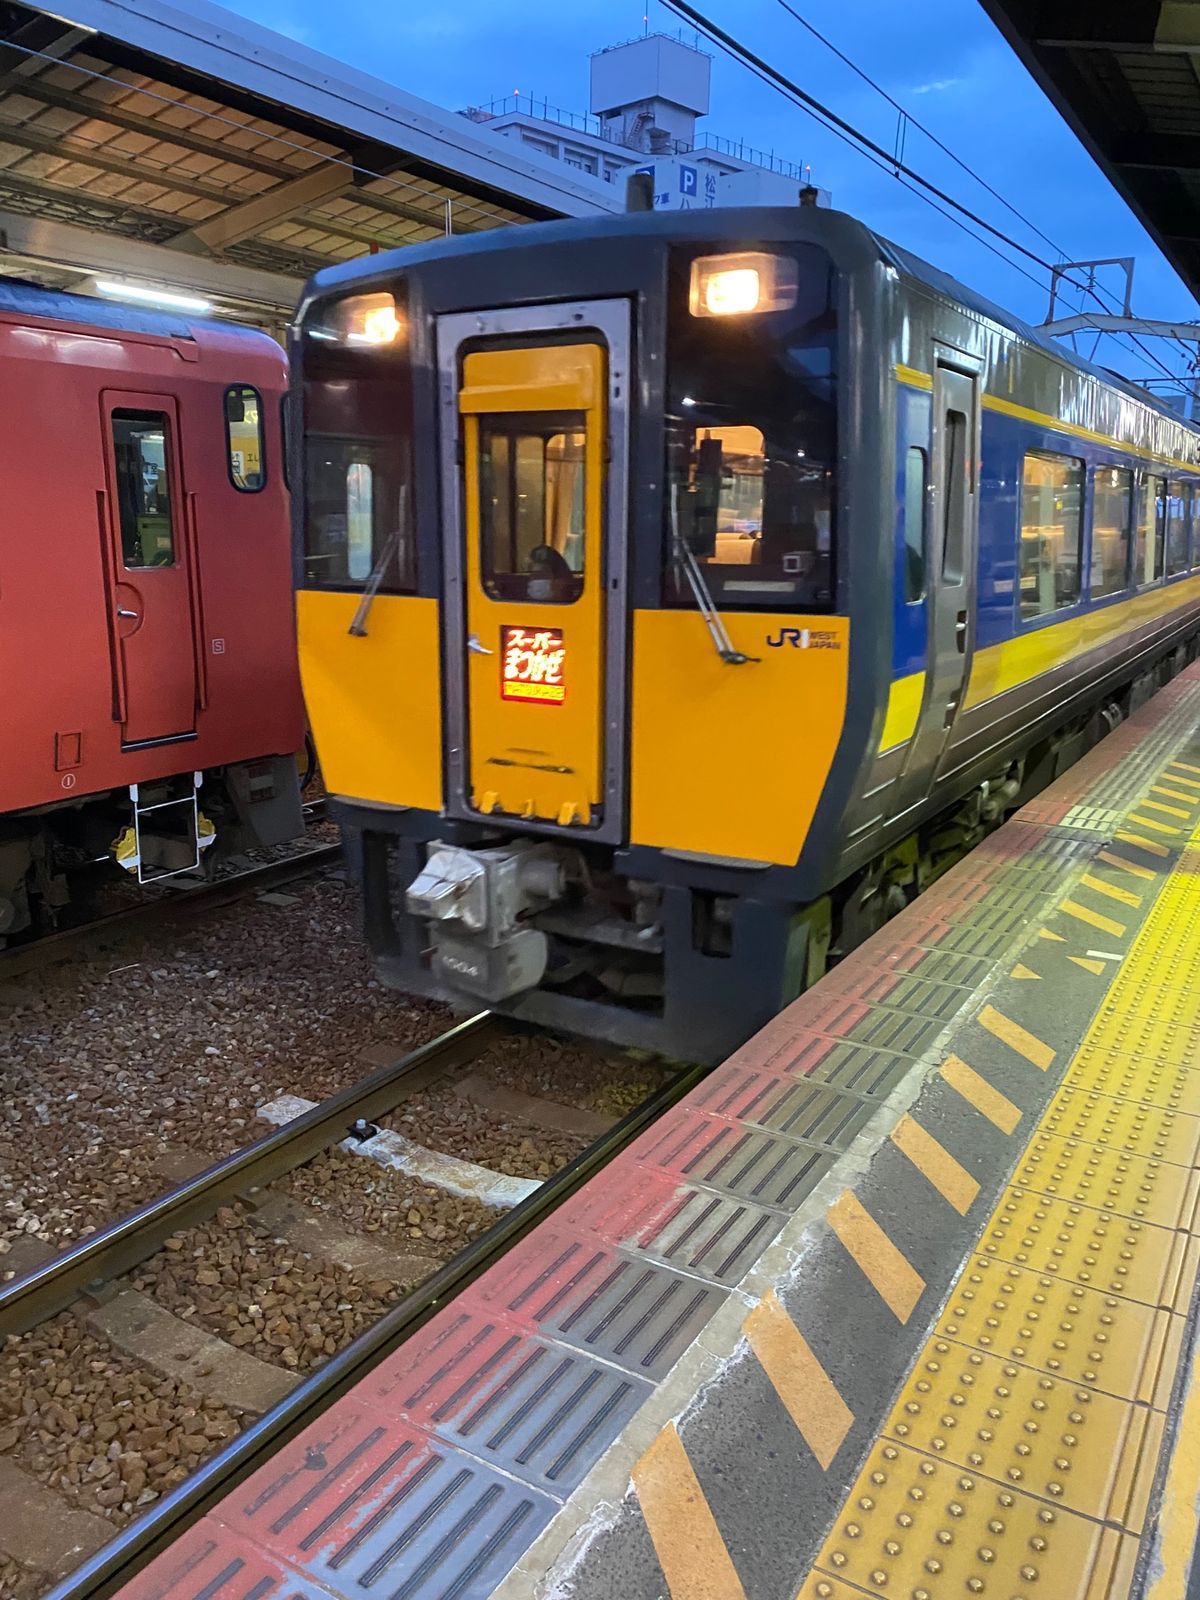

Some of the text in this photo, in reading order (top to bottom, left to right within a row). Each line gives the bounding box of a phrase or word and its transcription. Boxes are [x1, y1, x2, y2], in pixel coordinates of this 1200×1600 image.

[684, 171, 694, 192] P
[507, 629, 562, 650] スーパー
[766, 628, 800, 648] JR
